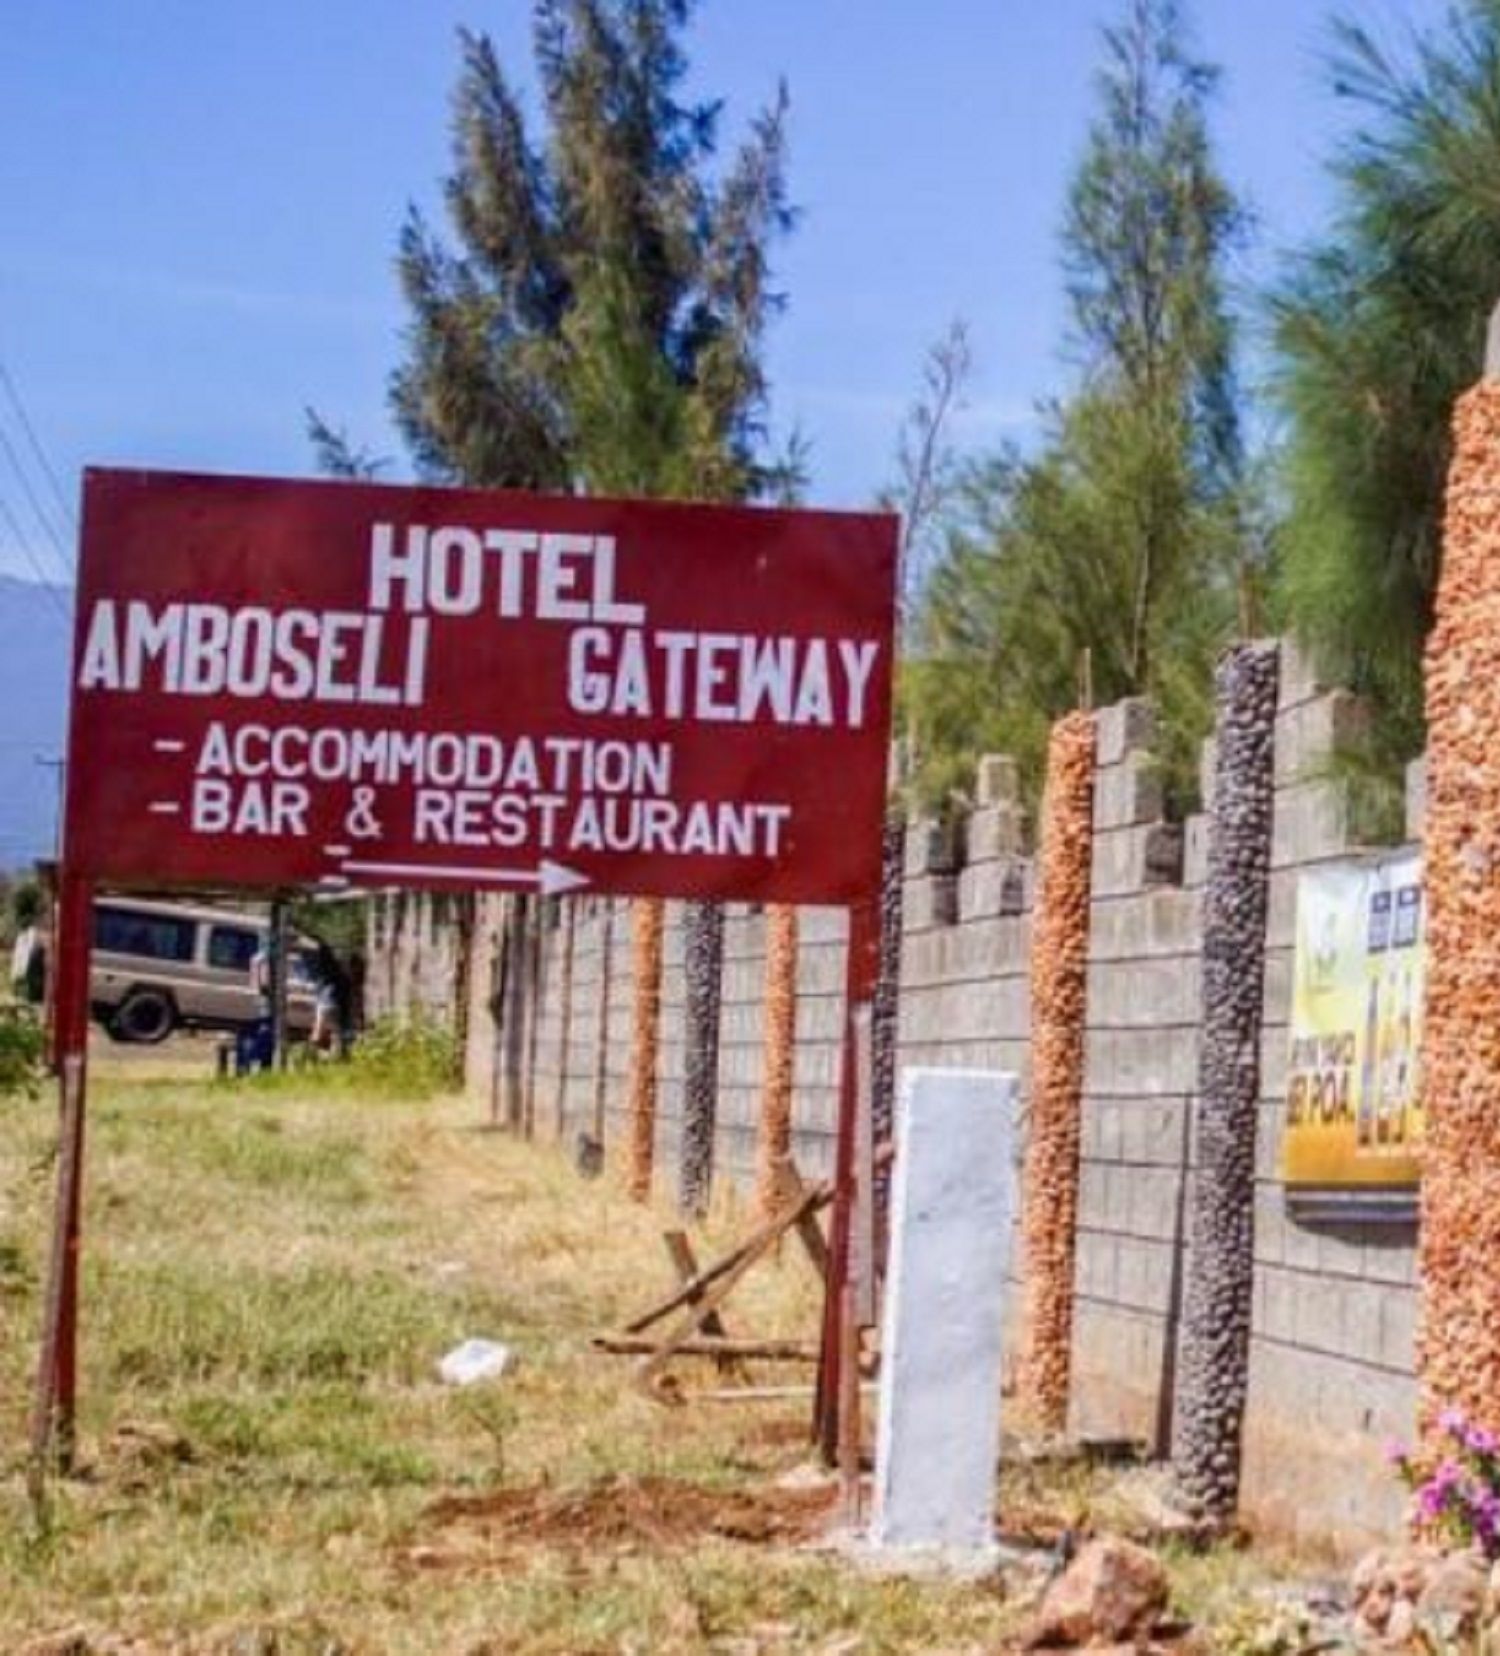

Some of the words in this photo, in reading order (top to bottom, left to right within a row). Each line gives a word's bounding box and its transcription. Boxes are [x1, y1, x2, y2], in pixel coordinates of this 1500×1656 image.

[369, 522, 646, 626] HOTEL
[80, 600, 428, 706] AMBOSELI
[568, 627, 878, 728] GATEWAY
[196, 721, 673, 796] ACCOMMODATION
[191, 779, 309, 836] BAR
[346, 786, 382, 837] &
[414, 789, 791, 857] RESTAURANT
